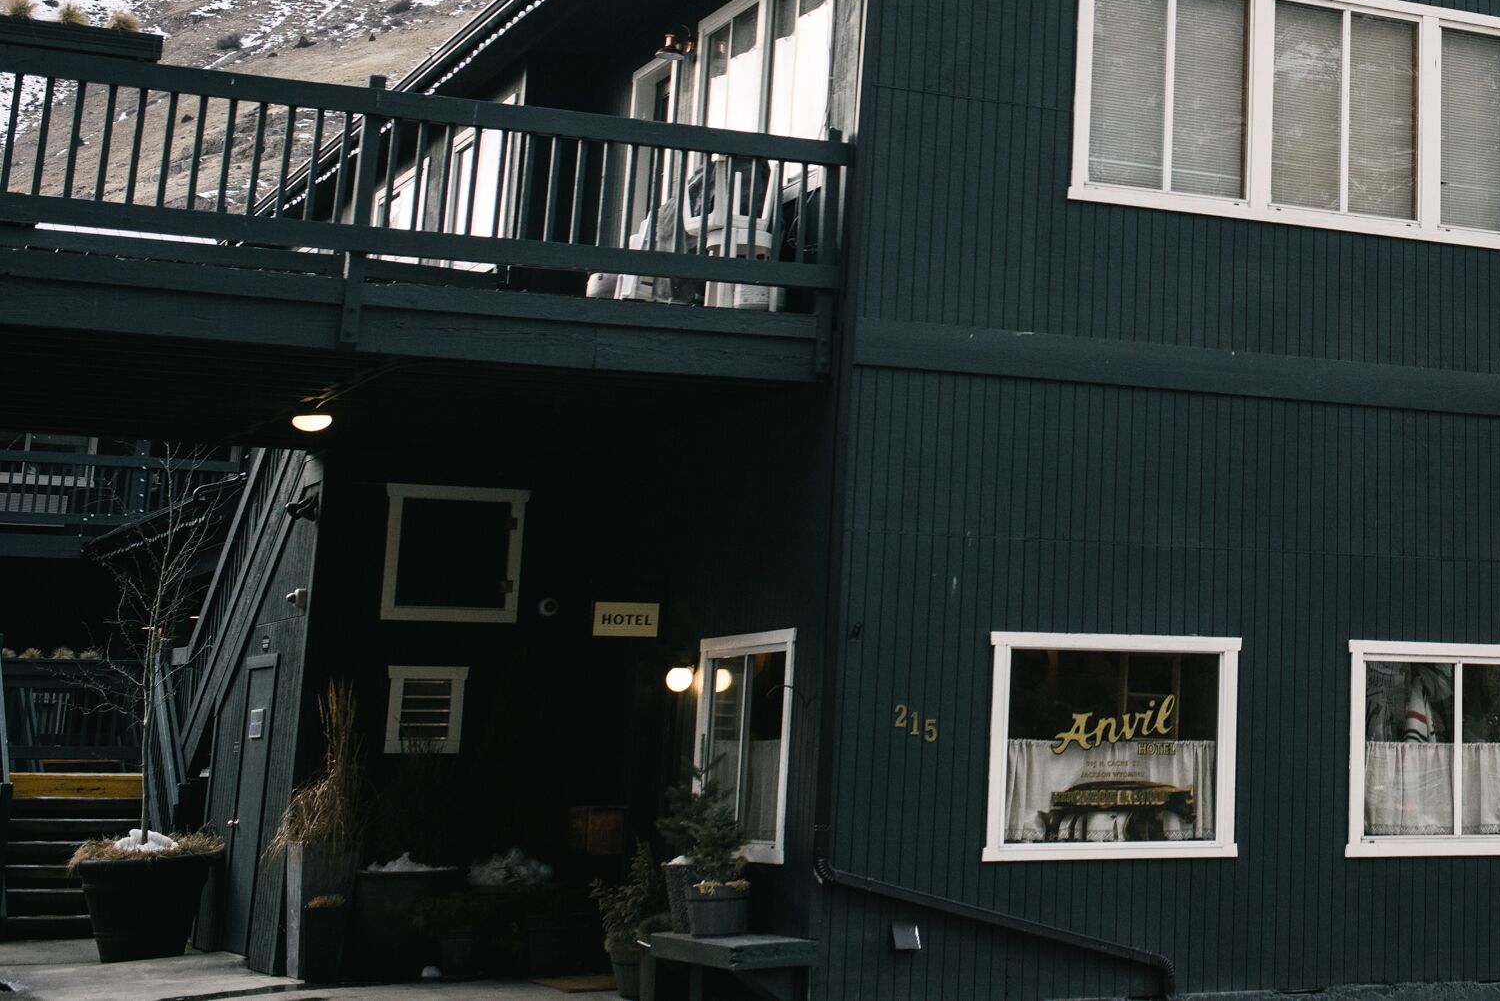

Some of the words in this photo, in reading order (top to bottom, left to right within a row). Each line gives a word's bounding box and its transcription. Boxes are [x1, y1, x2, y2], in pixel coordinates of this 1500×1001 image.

[601, 613, 653, 626] HOTEL
[894, 704, 938, 743] 215
[1051, 694, 1176, 755] Anvil
[1136, 742, 1176, 756] HOTEL
